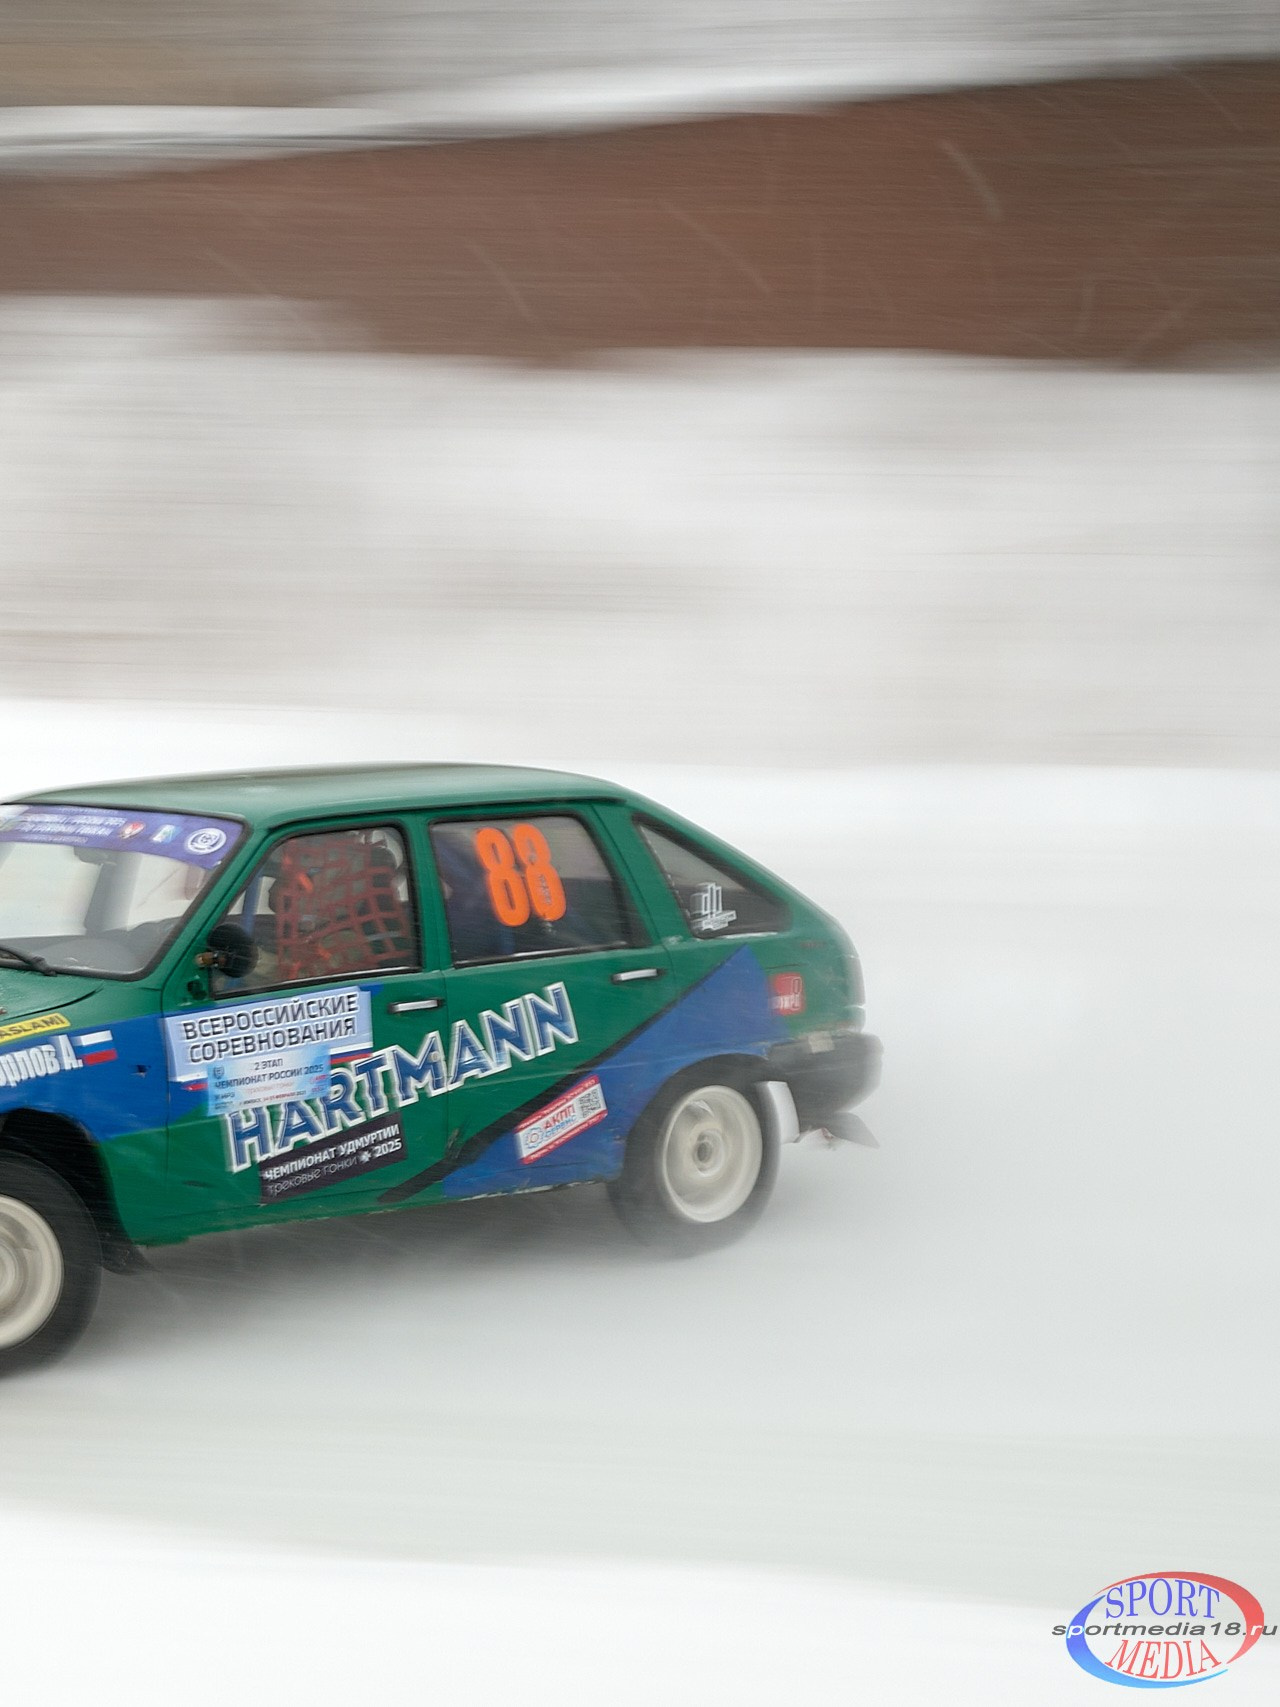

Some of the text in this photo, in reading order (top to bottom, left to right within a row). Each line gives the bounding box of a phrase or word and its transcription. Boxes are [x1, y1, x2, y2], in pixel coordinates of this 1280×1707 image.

[475, 823, 566, 927] 88
[182, 993, 360, 1042] ВСЕРОССИЙСКИЕ
[189, 1018, 355, 1063] СОРЕВНОВАНИЯ
[214, 1073, 266, 1089] ЧЕМПИОНАТ
[269, 1069, 302, 1081] РОССИИ
[224, 981, 580, 1174] HARTMANN
[254, 1058, 283, 1071] 2 ЭТАП
[544, 1104, 575, 1129] АКПП
[263, 1123, 400, 1180] ЧЕМПИОНАТ УДМУРТИИ
[374, 1138, 402, 1157] 2025
